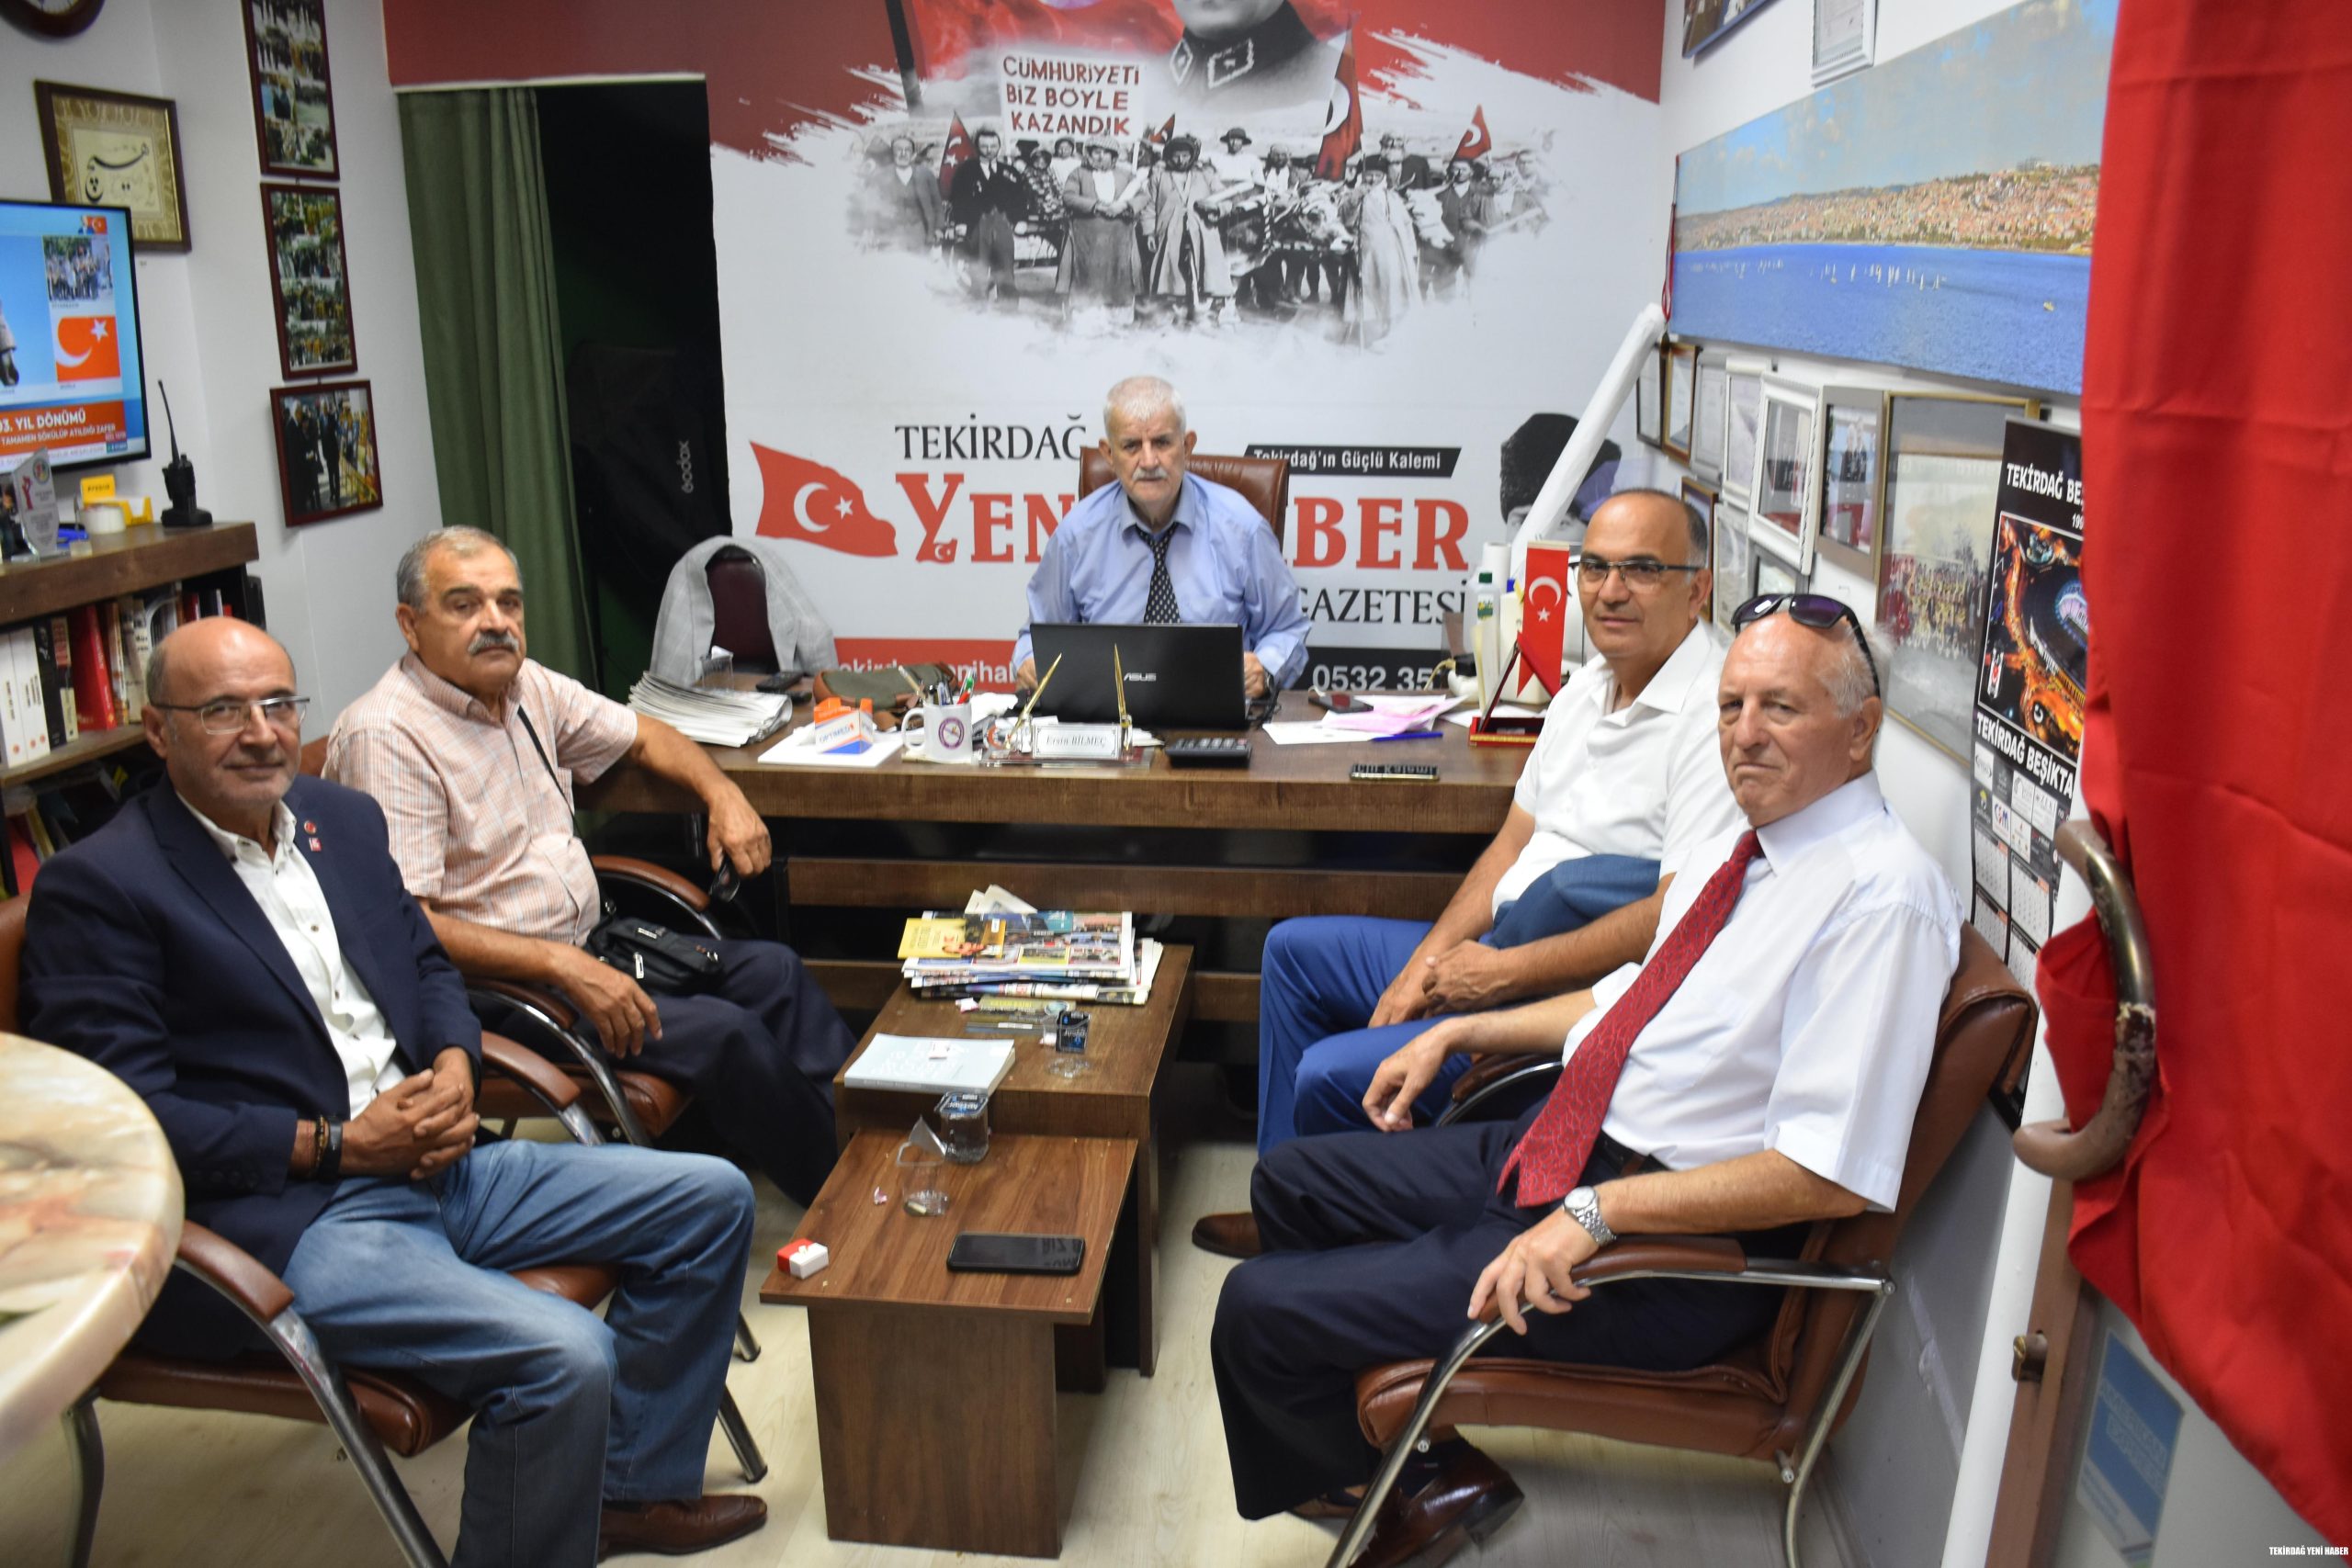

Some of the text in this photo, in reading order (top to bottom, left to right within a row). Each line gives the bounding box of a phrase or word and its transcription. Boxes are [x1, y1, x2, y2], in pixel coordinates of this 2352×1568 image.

[1006, 84, 1128, 110] BİZ BÖYLE
[1012, 111, 1129, 136] KAZANDIK
[15, 416, 34, 431] YIL
[37, 408, 85, 428] DÖNÜMÜ
[2, 433, 37, 446] TAMAMEN
[38, 428, 67, 441] SÖKÜLÜP
[96, 423, 116, 434] ZAFER
[895, 412, 1086, 460] TEKİRDAĞ
[1341, 450, 1384, 471] Güçlü
[1389, 451, 1441, 469] Kalemi
[2007, 463, 2085, 507] TEKİRDAĞ BE
[896, 473, 1468, 571] YEN BER
[1124, 672, 1157, 682] ASUS
[1312, 664, 1386, 691] 0532
[1977, 711, 2026, 764] TEKİRDAĞ
[2026, 746, 2074, 799] BEŞİKTA
